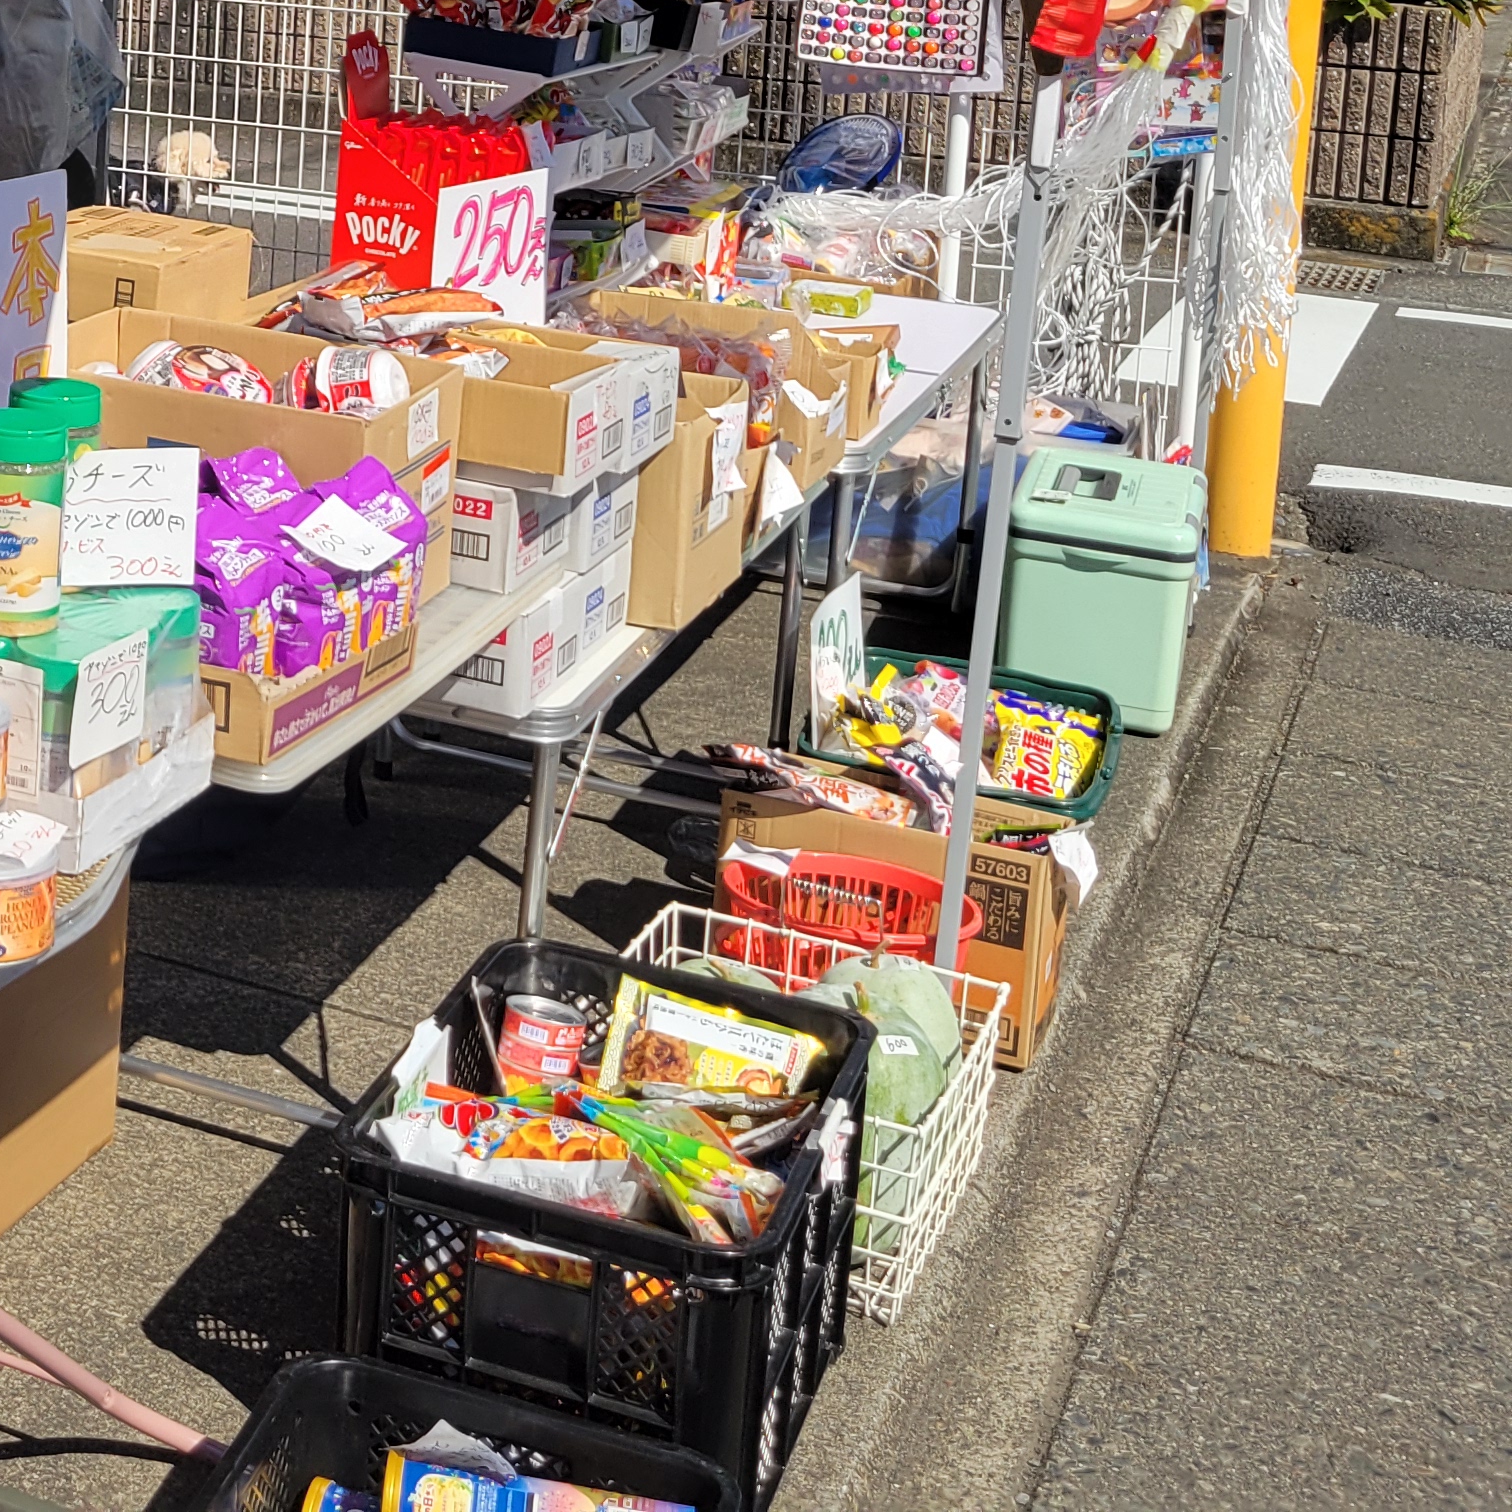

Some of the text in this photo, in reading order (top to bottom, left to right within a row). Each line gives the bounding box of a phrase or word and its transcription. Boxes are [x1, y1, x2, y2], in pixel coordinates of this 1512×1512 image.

[974, 857, 1028, 882] 57603
[986, 887, 1002, 939] こだわる
[1005, 890, 1022, 934] 旨みに
